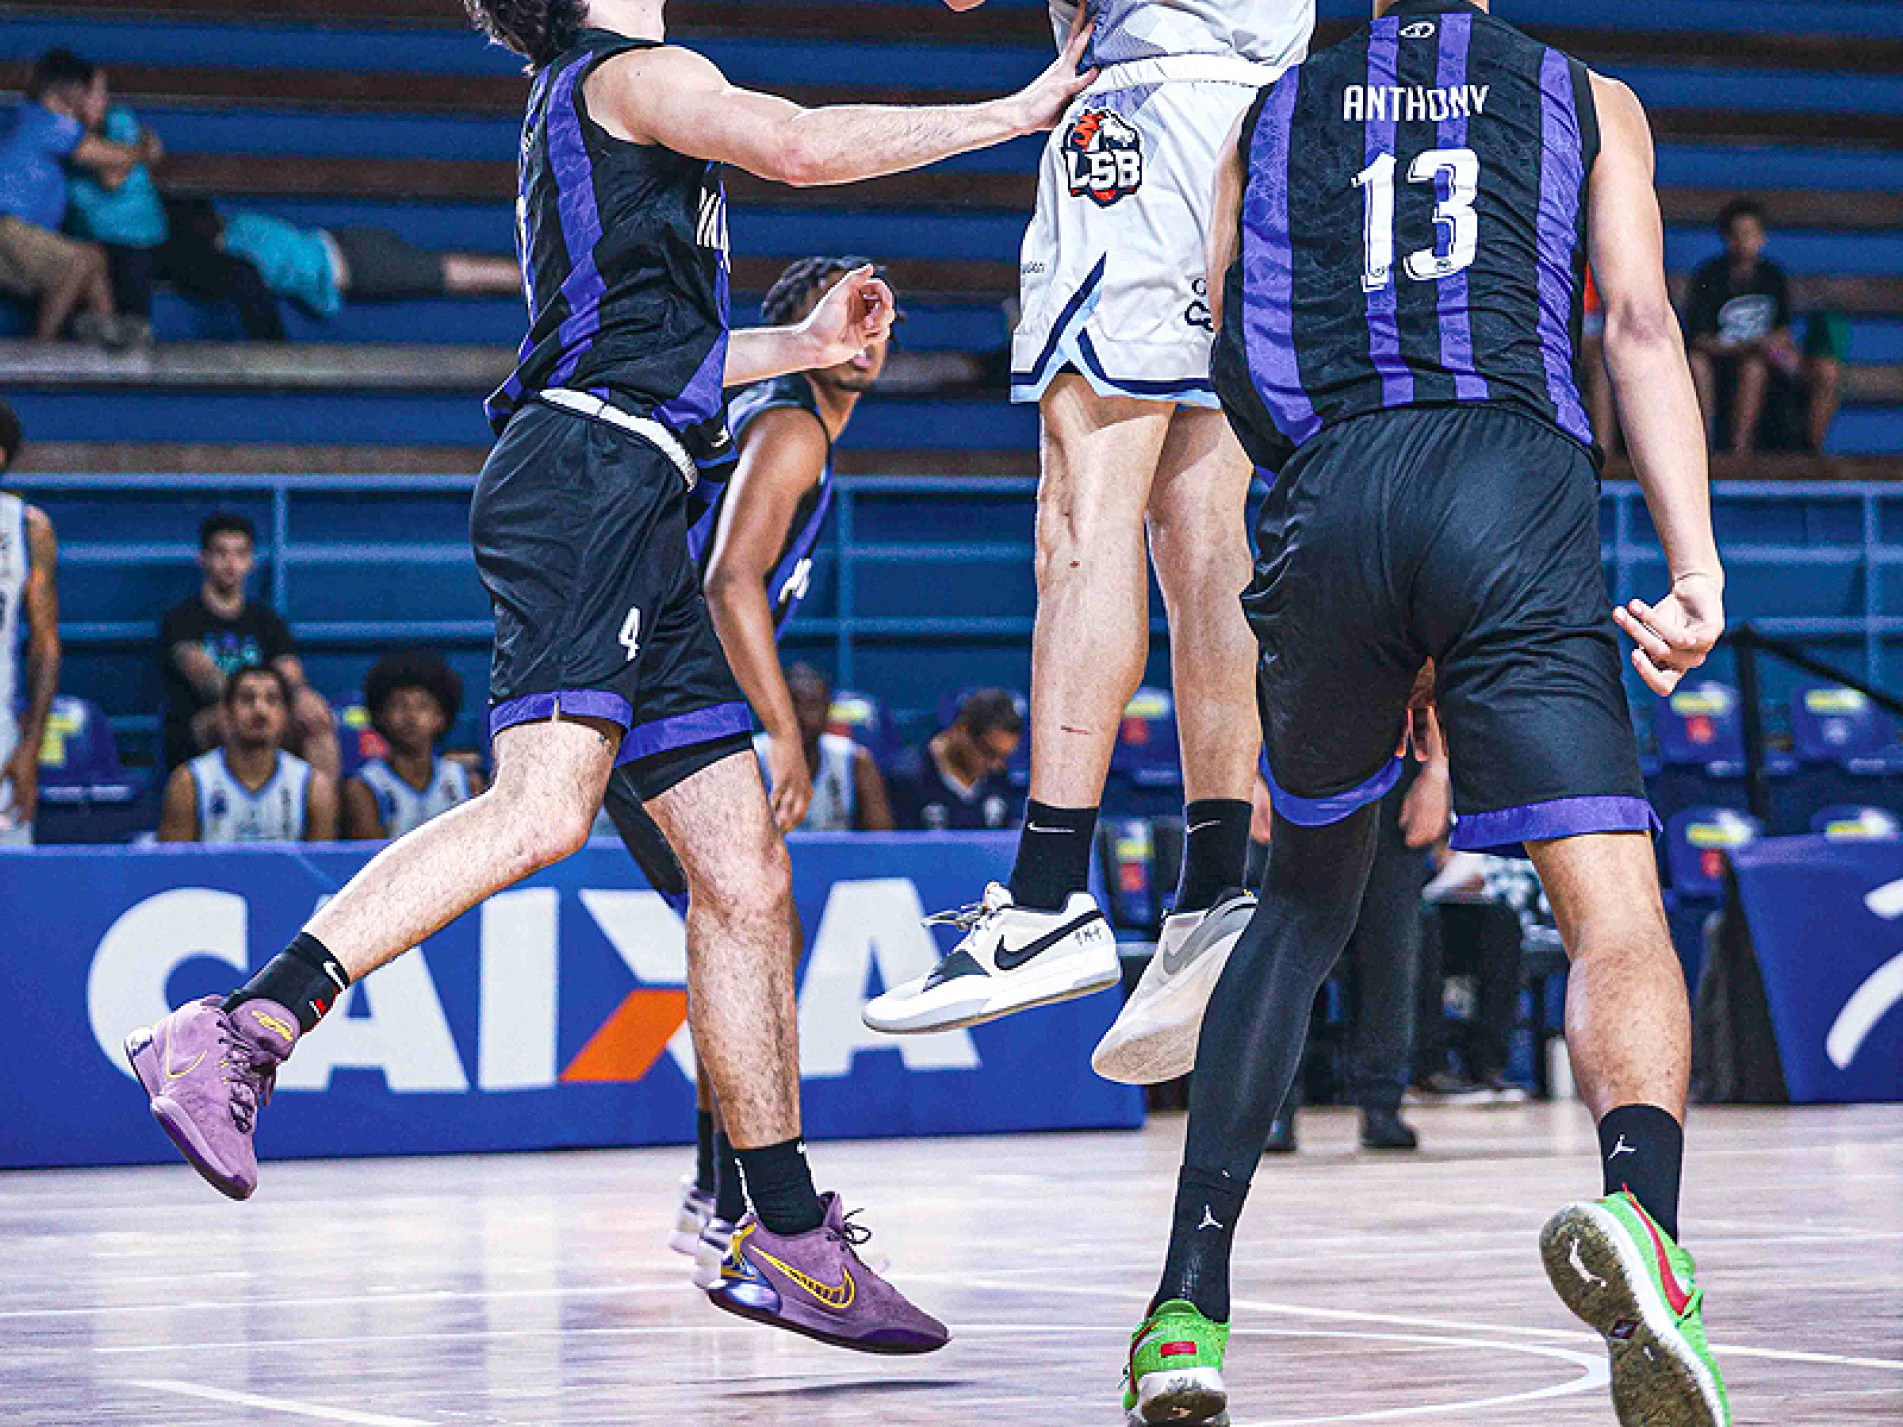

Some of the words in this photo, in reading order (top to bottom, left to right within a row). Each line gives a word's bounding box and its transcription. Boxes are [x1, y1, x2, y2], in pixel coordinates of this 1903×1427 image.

[1342, 83, 1490, 122] ANTHONY
[1065, 149, 1140, 188] LSB
[1351, 148, 1480, 293] 13
[618, 605, 641, 662] 4
[88, 876, 980, 1093] CAIXA
